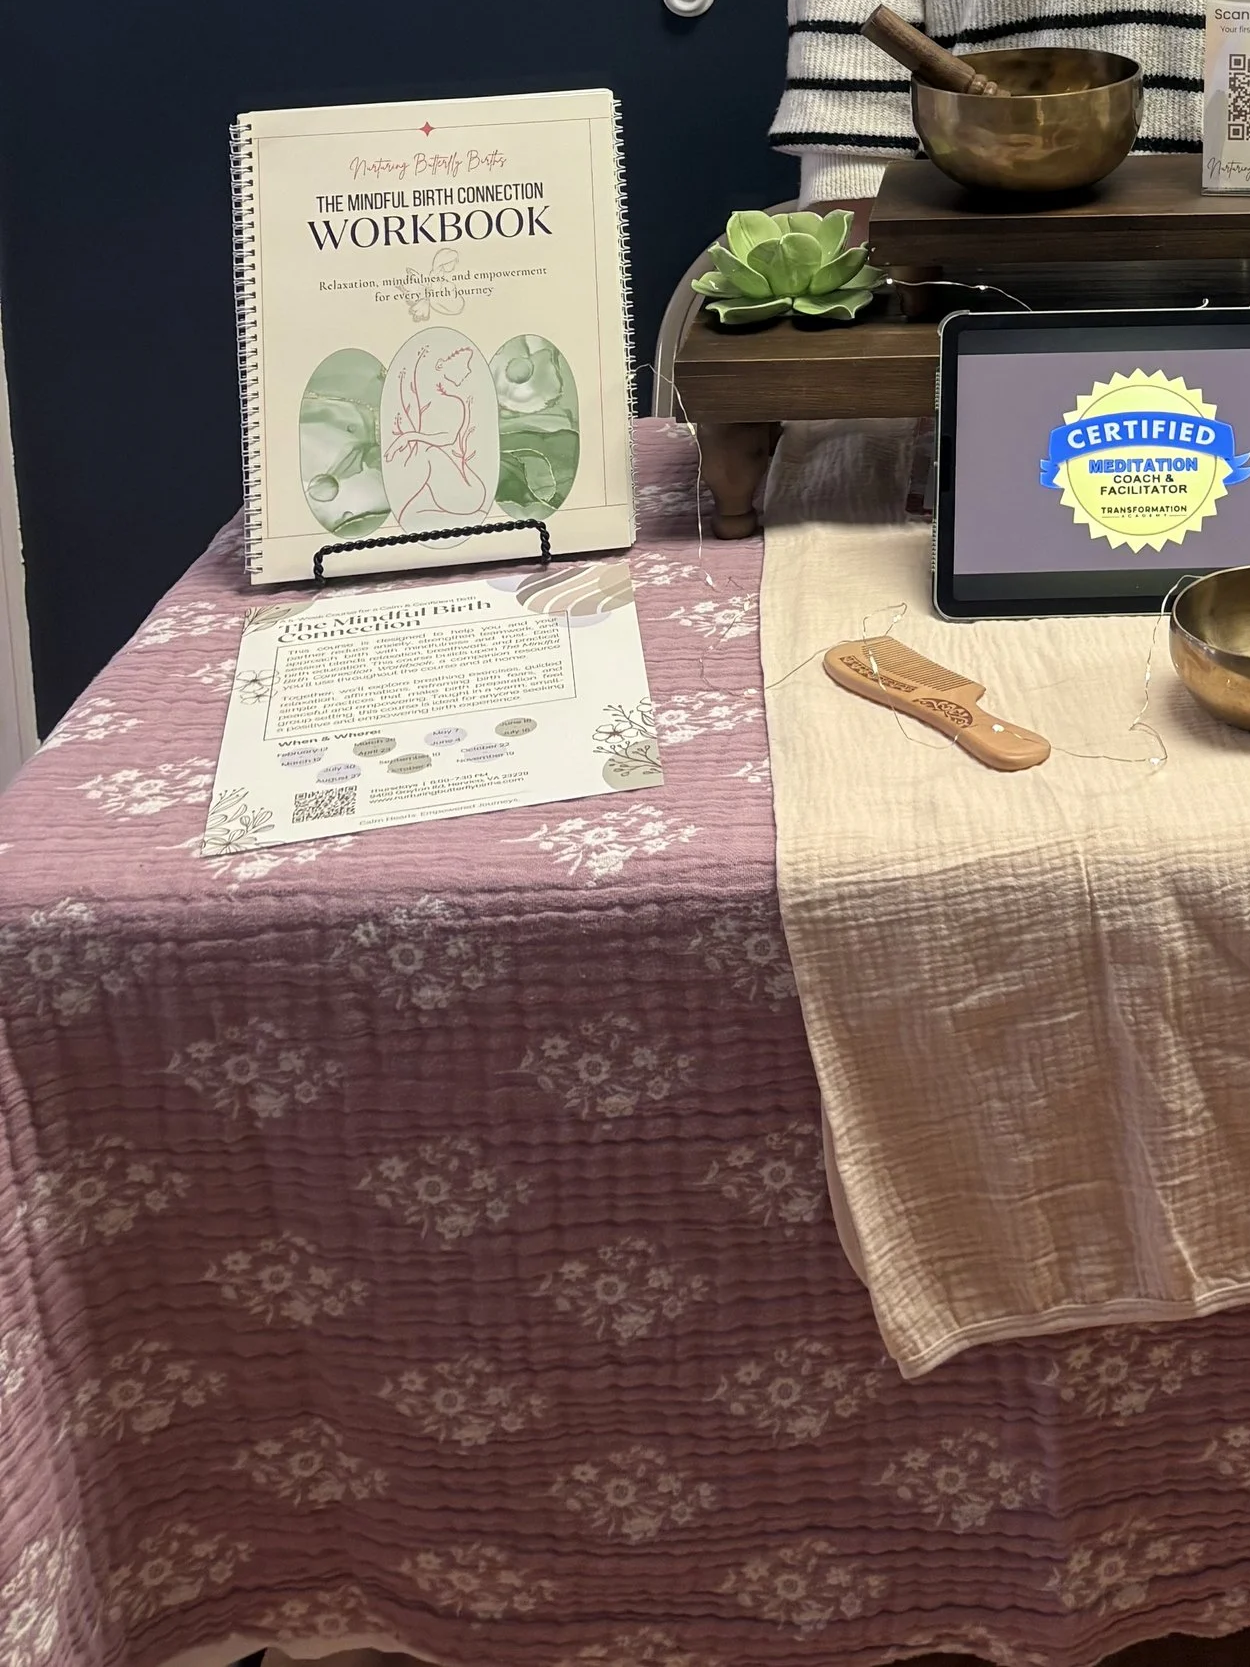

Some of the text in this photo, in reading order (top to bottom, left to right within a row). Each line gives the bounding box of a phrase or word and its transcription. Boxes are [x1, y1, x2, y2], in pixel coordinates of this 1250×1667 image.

[1215, 9, 1249, 20] Scan
[350, 149, 507, 181] Nurturing Butterfly Births
[316, 182, 544, 213] THE MINDFUL BIRTH CONNECTION
[307, 206, 552, 251] WORKBOOK
[319, 266, 547, 291] Relaxation, mindfulness, and empowerment
[374, 285, 494, 303] for every birth journey
[1067, 419, 1216, 449] CERTIFIED
[1089, 458, 1198, 474] MEDITATION
[1100, 485, 1187, 495] FACILITATOR
[1113, 474, 1174, 484] COACH &
[1101, 505, 1187, 514] TRANSFORMATION
[280, 600, 491, 634] The Mindful Birth
[278, 620, 420, 643] Connection
